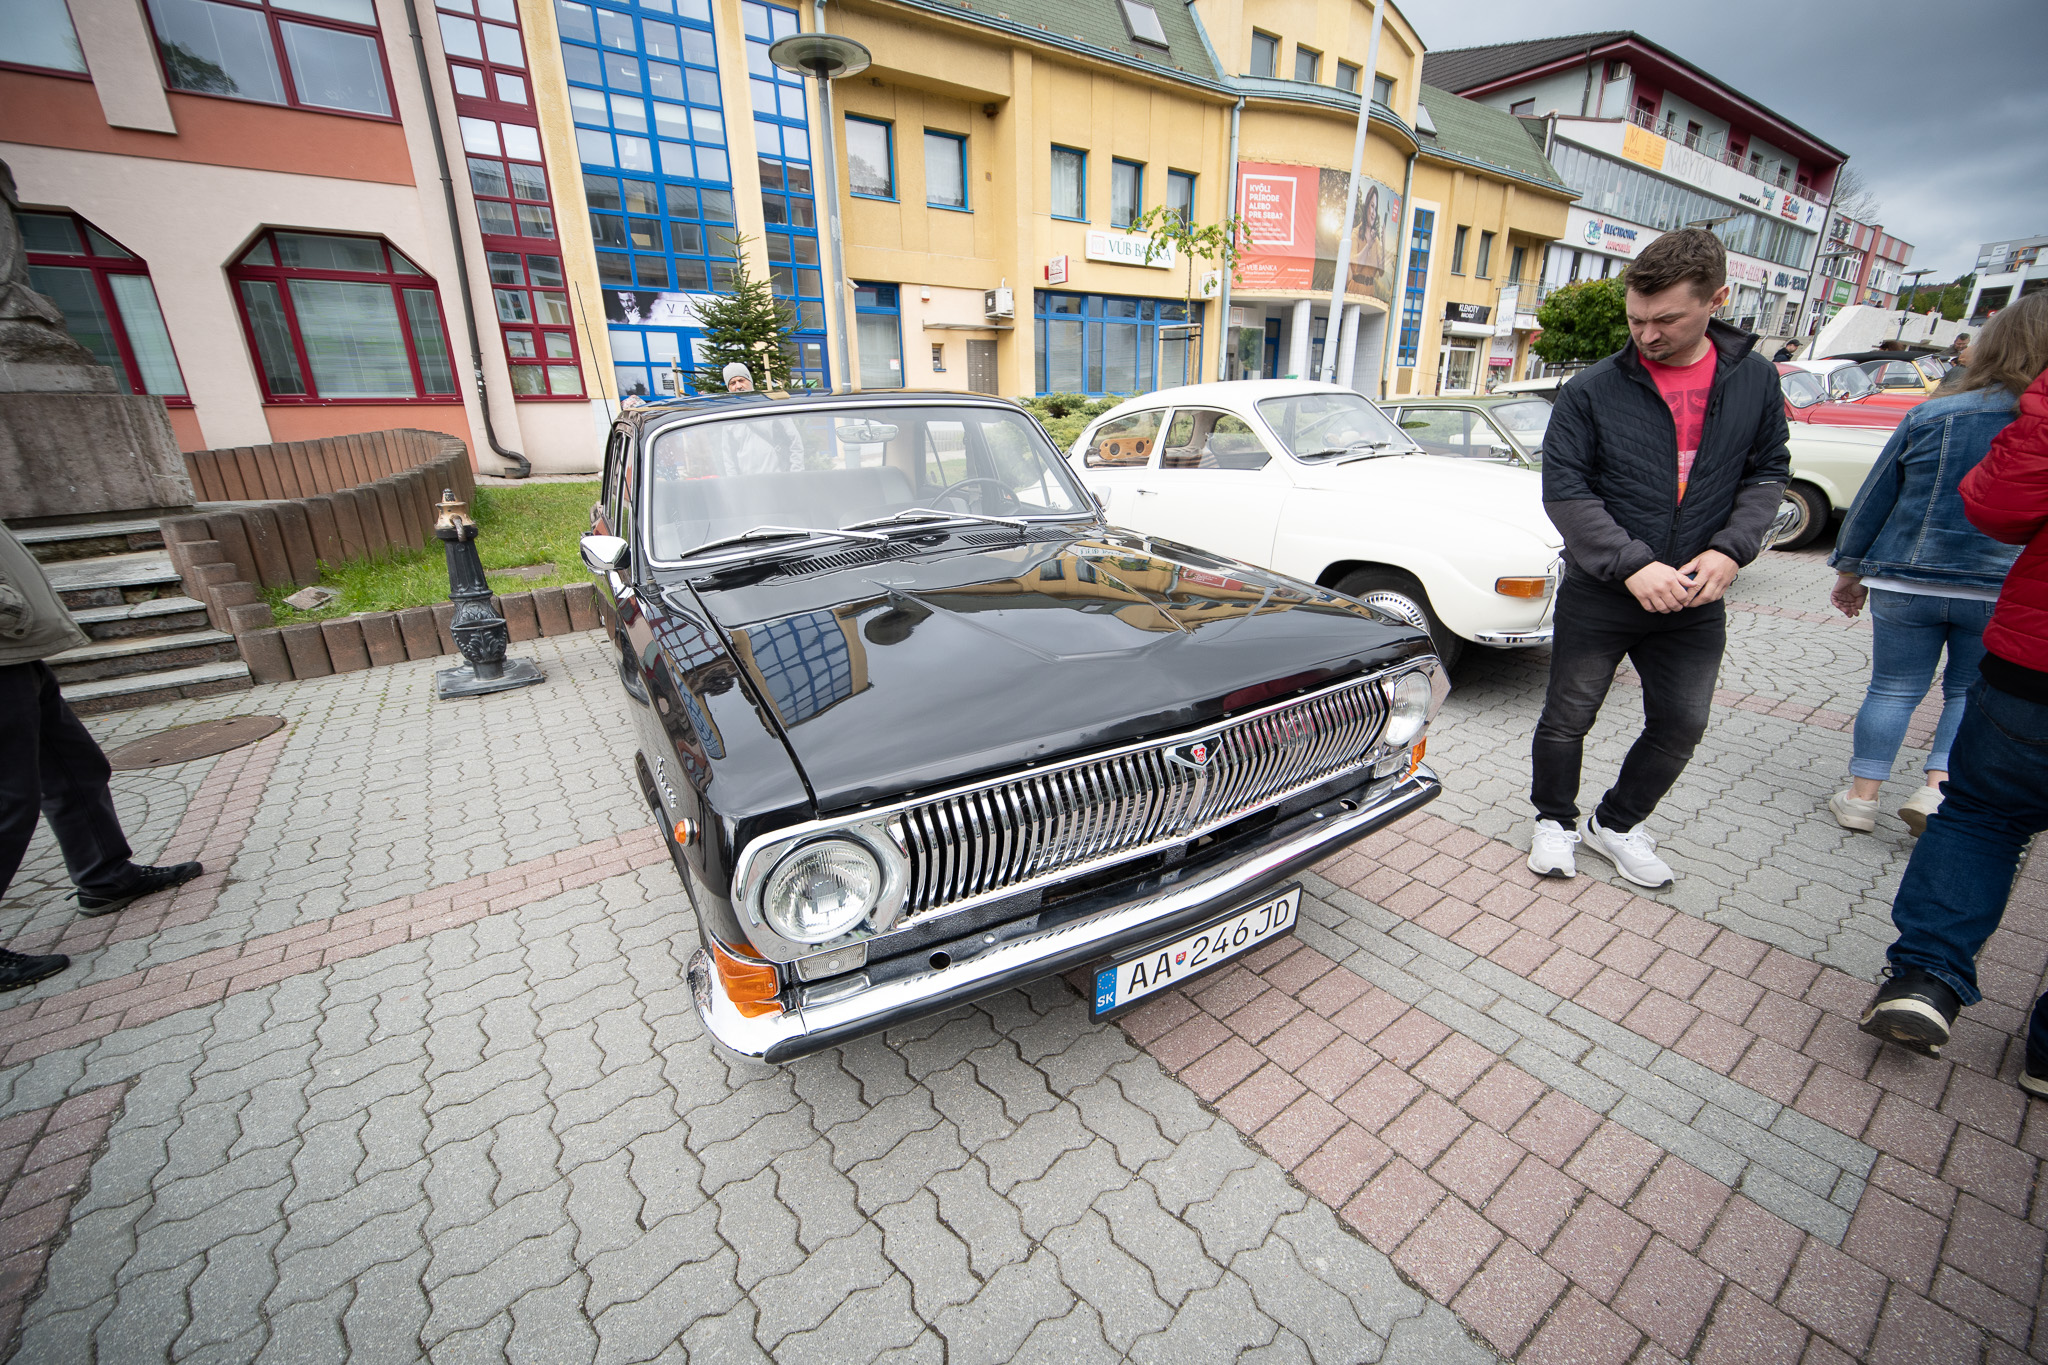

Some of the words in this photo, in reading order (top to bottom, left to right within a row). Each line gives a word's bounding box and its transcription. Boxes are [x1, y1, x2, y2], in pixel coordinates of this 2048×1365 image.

[1249, 183, 1271, 193] KVÔLI
[1249, 192, 1280, 202] PRÍRODE
[1248, 202, 1271, 210] ALEBO
[1248, 210, 1262, 219] PRE
[1262, 211, 1284, 220] SEBA?
[1603, 223, 1638, 241] ELECTRONIC
[1108, 237, 1132, 255] VÚB
[1128, 952, 1172, 995] AA
[1190, 899, 1290, 968] 246JD
[1096, 991, 1114, 1008] SK
